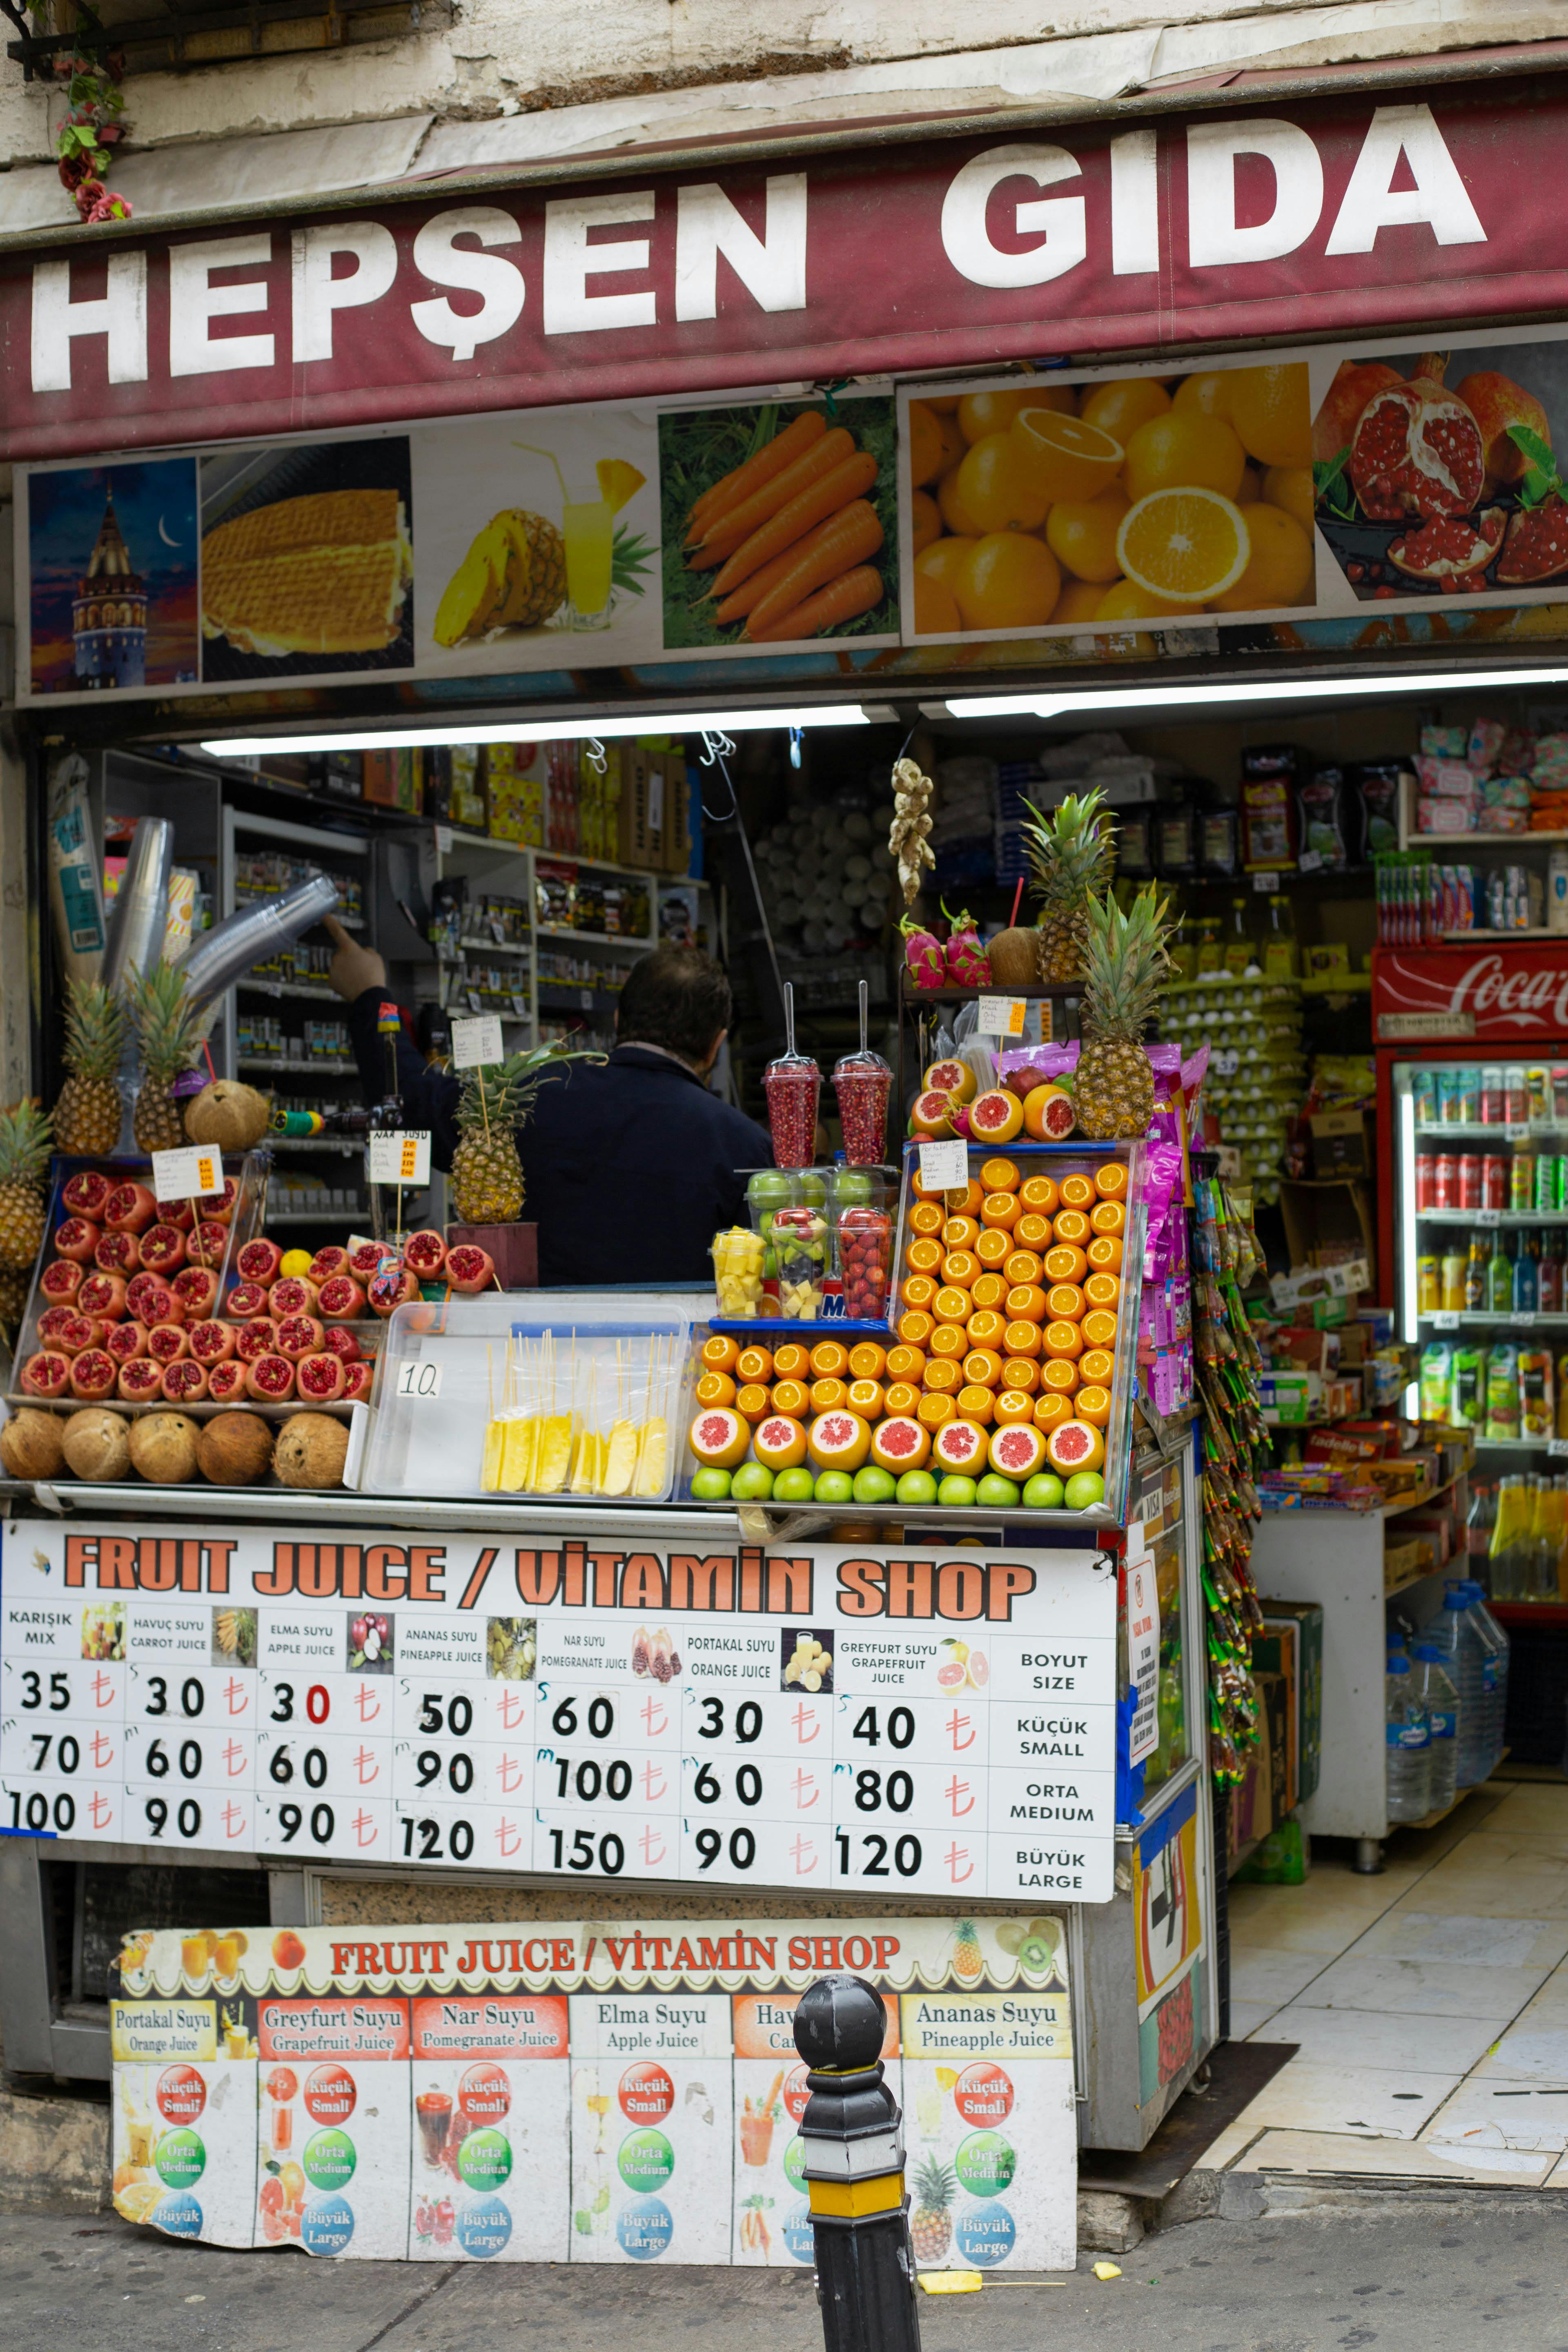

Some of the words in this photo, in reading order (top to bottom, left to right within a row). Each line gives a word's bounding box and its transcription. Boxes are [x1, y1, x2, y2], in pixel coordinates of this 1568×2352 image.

[31, 172, 807, 393] HEPŞEN
[940, 102, 1488, 288] GIDA
[1147, 1492, 1160, 1520] VISA
[64, 1535, 238, 1594] FRUIT
[253, 1541, 446, 1602] JUICE
[836, 1559, 1036, 1622] SHOP
[10, 1611, 71, 1627] KARIŞIK
[134, 1619, 171, 1630] HAVUÇ
[176, 1621, 203, 1630] SUYU
[25, 1632, 55, 1644] MIX
[271, 1626, 299, 1634] ELMA
[304, 1627, 332, 1636] SUYU
[407, 1630, 448, 1640] ANANAS
[452, 1632, 477, 1642] SUYU
[131, 1638, 172, 1647] CARROT
[177, 1640, 205, 1649] JUICE
[269, 1644, 300, 1653] APPLE
[306, 1646, 334, 1655] JUICE
[565, 1636, 580, 1645] NAR
[584, 1637, 604, 1646] SUYU
[688, 1637, 742, 1651] PORTAKAL
[747, 1640, 774, 1652] SUYU
[841, 1643, 901, 1653] GREYFURT
[906, 1645, 936, 1655] SUYU
[401, 1650, 452, 1661] PINEAPPLE
[456, 1653, 481, 1662] JUICE
[542, 1656, 602, 1668] POMEGRANATE
[606, 1659, 626, 1669] JUICE
[852, 1658, 925, 1669] GRAPEFRUIT
[1022, 1654, 1087, 1668] BOYUT
[692, 1664, 737, 1676] ORANGE
[742, 1666, 770, 1678] JUICE
[872, 1674, 904, 1683] JUICE
[22, 1671, 70, 1711] 35
[1033, 1677, 1074, 1690] SIZE
[146, 1677, 204, 1717] 30
[271, 1683, 329, 1724] 30
[419, 1695, 472, 1735] 50
[553, 1697, 613, 1738] 60
[698, 1697, 762, 1743] 30
[853, 1707, 914, 1748] 40
[1018, 1717, 1087, 1737] KÜÇÜK
[32, 1735, 79, 1773] 70
[1020, 1742, 1083, 1756] SMALL
[147, 1740, 201, 1779] 60
[270, 1745, 327, 1788] 60
[416, 1751, 473, 1793] 90
[556, 1758, 632, 1801] 100
[695, 1762, 762, 1805] 60
[855, 1770, 913, 1812] 80
[1027, 1784, 1078, 1798] ORTA
[7, 1792, 75, 1834] 100
[146, 1798, 200, 1838] 90
[1010, 1806, 1094, 1821] MEDIUM
[279, 1804, 334, 1843] 90
[401, 1818, 473, 1860] 120
[547, 1829, 624, 1875] 150
[696, 1828, 755, 1869] 90
[835, 1832, 921, 1876] 120
[1017, 1849, 1085, 1866] BÜYÜK
[1019, 1874, 1082, 1888] LARGE
[331, 1941, 448, 1975] FRUIT
[457, 1939, 575, 1973] JUICE
[789, 1936, 900, 1970] SHOP
[116, 2010, 173, 2029] Portakal
[177, 2010, 211, 2031] Suyu
[265, 2009, 348, 2031] Greyfurt
[353, 2008, 401, 2029] Suyu
[443, 2006, 479, 2025] Nar
[486, 2006, 535, 2028] Suyu
[598, 2005, 649, 2023] Elma
[656, 2005, 706, 2027] Suyu
[756, 2005, 796, 2024] Hav
[917, 2003, 995, 2023] Ananas
[1002, 2003, 1057, 2026] Suyu
[129, 2038, 167, 2054] Orange
[170, 2039, 197, 2051] Juice
[273, 2035, 350, 2053] Grapefruit
[354, 2036, 394, 2050] Juice
[422, 2033, 514, 2049] Pomegranate
[519, 2032, 557, 2046] Juice
[607, 2033, 652, 2050] Apple
[656, 2034, 698, 2047] Juice
[922, 2031, 1003, 2050] Pineapple
[1009, 2031, 1053, 2046] Juice
[161, 2080, 202, 2097] Küçük
[309, 2080, 353, 2097] Küçük
[464, 2079, 508, 2096] Küçük
[624, 2079, 669, 2096] Küçük
[960, 2079, 1009, 2096] Küçük
[312, 2099, 349, 2113] Small
[467, 2098, 505, 2113] Small
[627, 2098, 666, 2113] Small
[964, 2099, 1006, 2114] Small
[167, 2144, 196, 2157] Orta
[315, 2144, 345, 2158] Orta
[470, 2145, 501, 2158] Orta
[630, 2145, 663, 2159] Orta
[969, 2147, 1002, 2163] Orta
[160, 2161, 201, 2173] Medium
[309, 2161, 352, 2174] Medium
[464, 2162, 508, 2174] Medium
[624, 2163, 669, 2176] Medium
[962, 2166, 1009, 2179] Medium
[158, 2209, 199, 2224] Büyük
[307, 2212, 350, 2228] Büyük
[463, 2214, 507, 2230] Büyük
[623, 2214, 668, 2231] Büyük
[962, 2218, 1011, 2236] Büyük
[309, 2231, 347, 2247] Large
[465, 2232, 504, 2249] Large
[624, 2233, 665, 2250] Large
[964, 2238, 1008, 2256] Large
